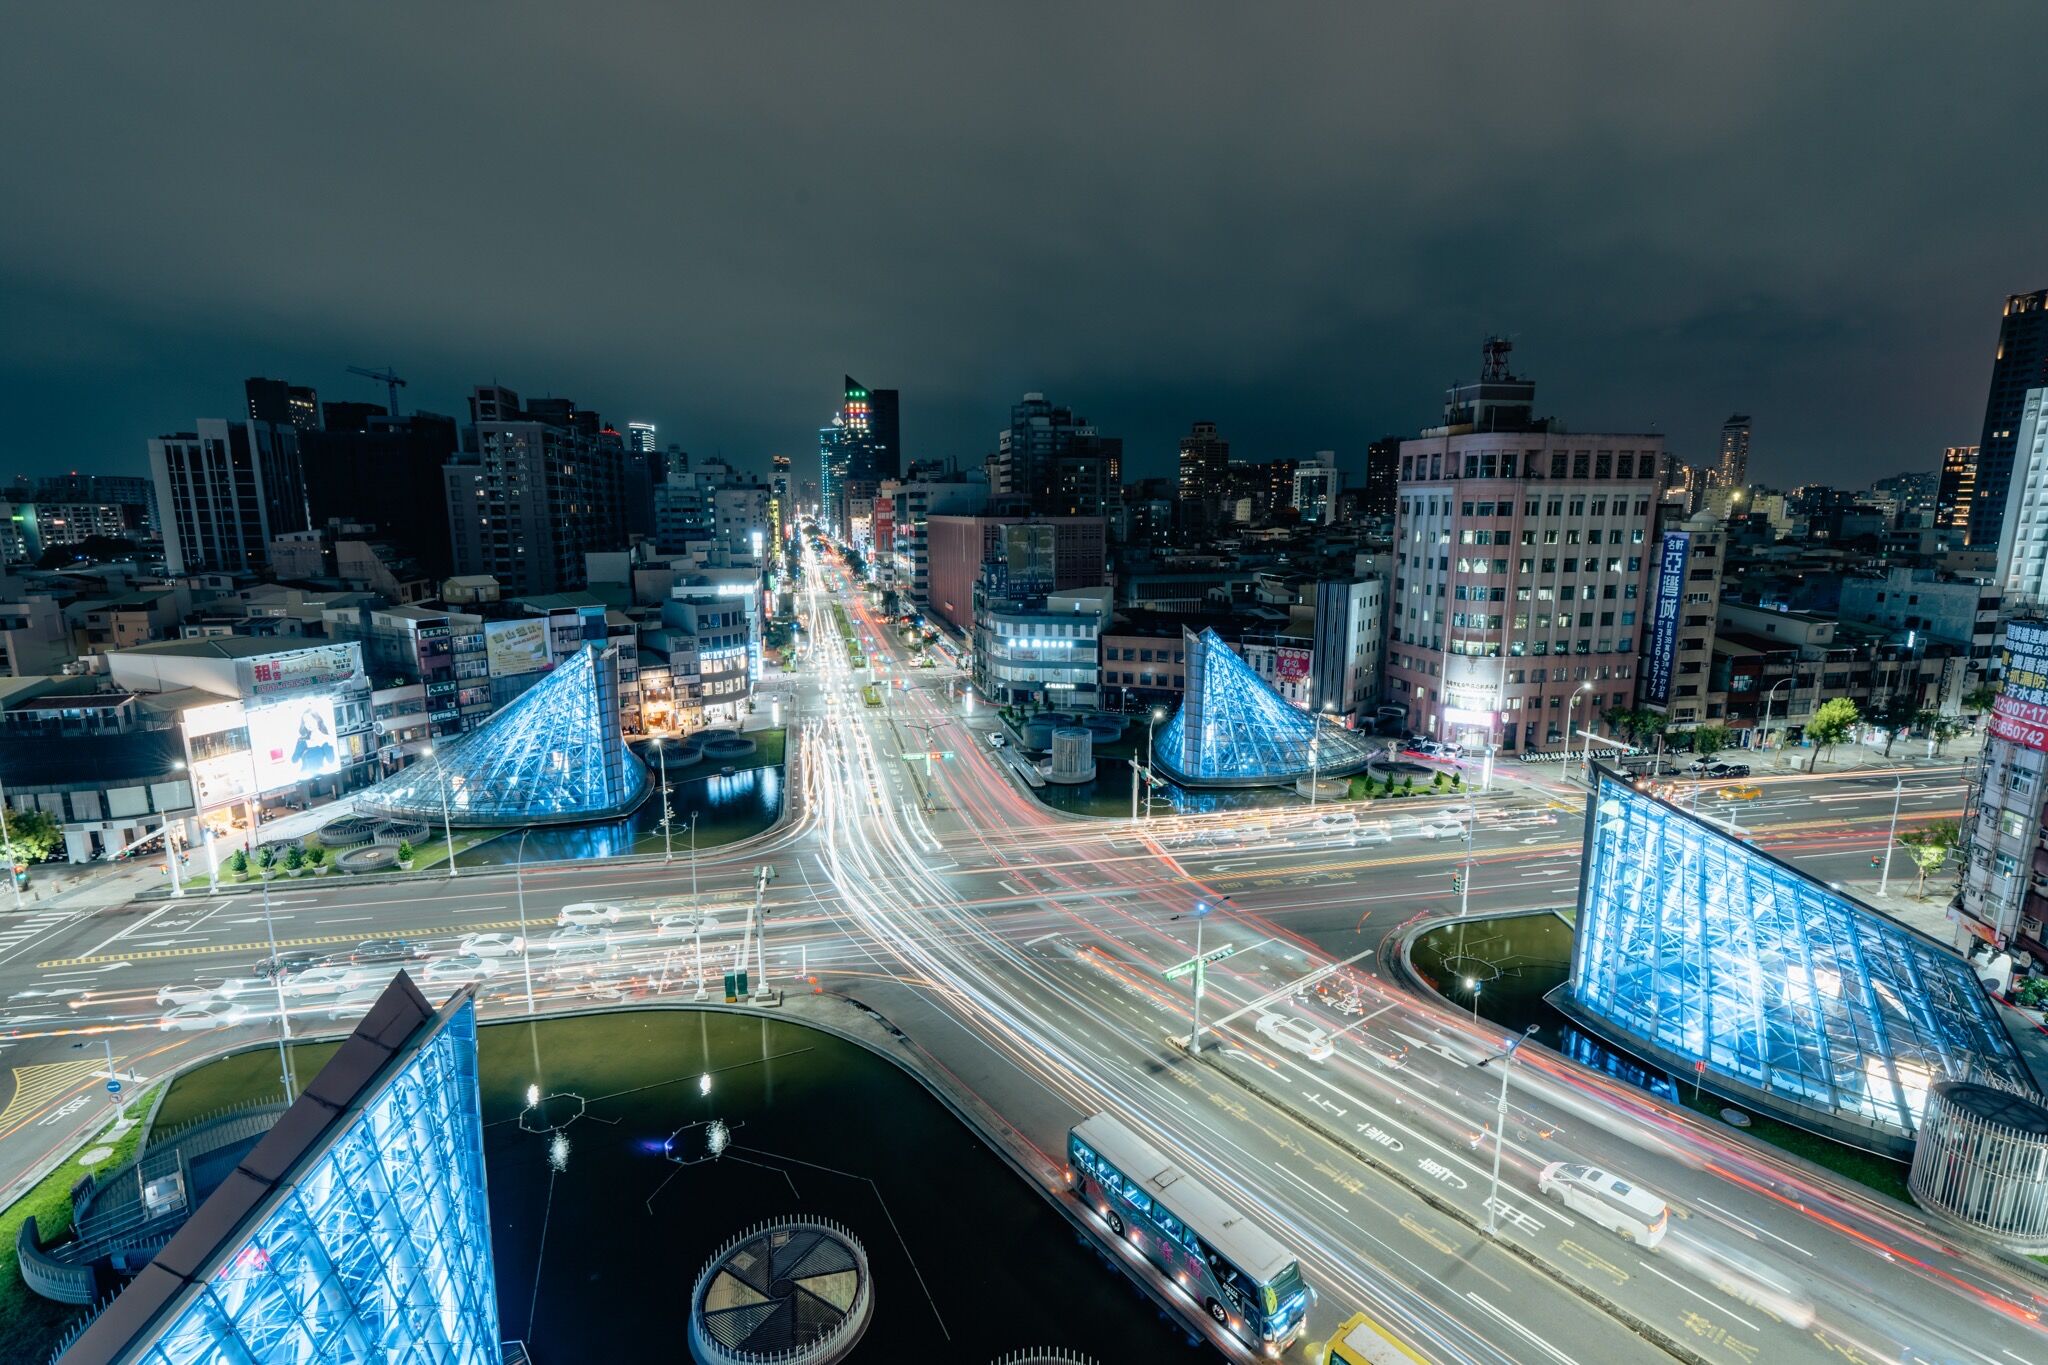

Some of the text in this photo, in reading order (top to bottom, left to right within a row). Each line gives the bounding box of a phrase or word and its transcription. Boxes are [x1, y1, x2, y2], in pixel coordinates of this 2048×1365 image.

[1667, 540, 1684, 550] 名軒
[1659, 552, 1683, 620] 亞灣城
[700, 650, 723, 660] SUIT
[2004, 639, 2048, 656] 有限公
[1650, 628, 1664, 697] 336-5777
[254, 664, 272, 682] 租
[2009, 668, 2048, 690] 抓漏防
